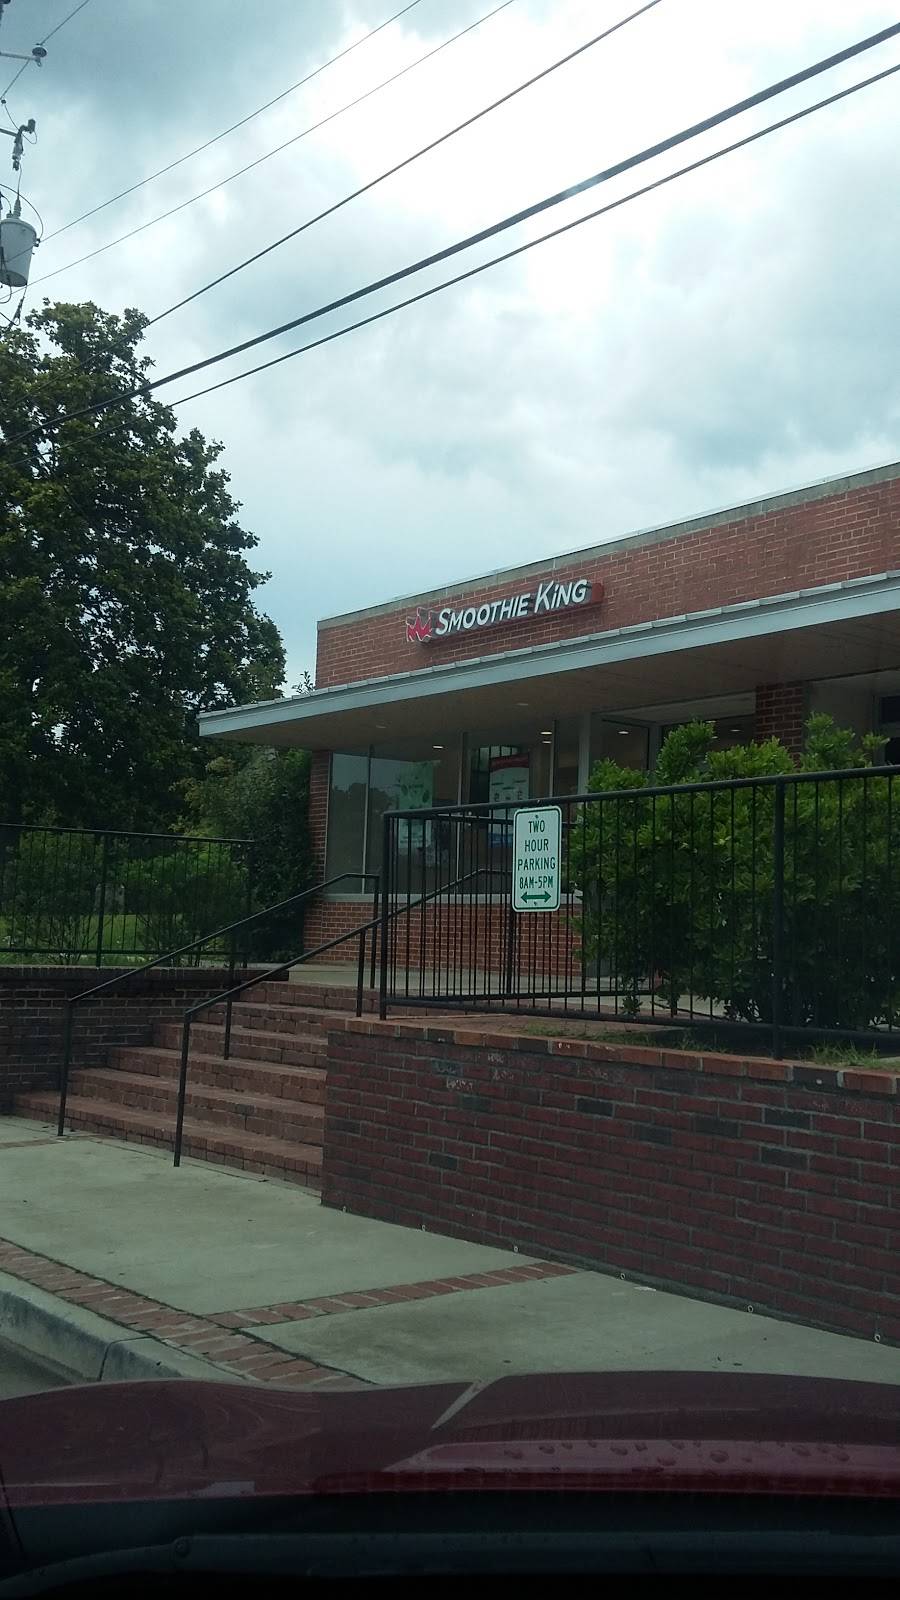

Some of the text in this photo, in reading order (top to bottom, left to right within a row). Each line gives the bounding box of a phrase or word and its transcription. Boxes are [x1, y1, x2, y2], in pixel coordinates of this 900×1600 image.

[435, 592, 531, 636] SMOOTHIE
[528, 820, 546, 833] TWO
[524, 839, 549, 852] HOUR
[517, 857, 556, 871] PARKING
[519, 876, 554, 889] 8AM-5PM
